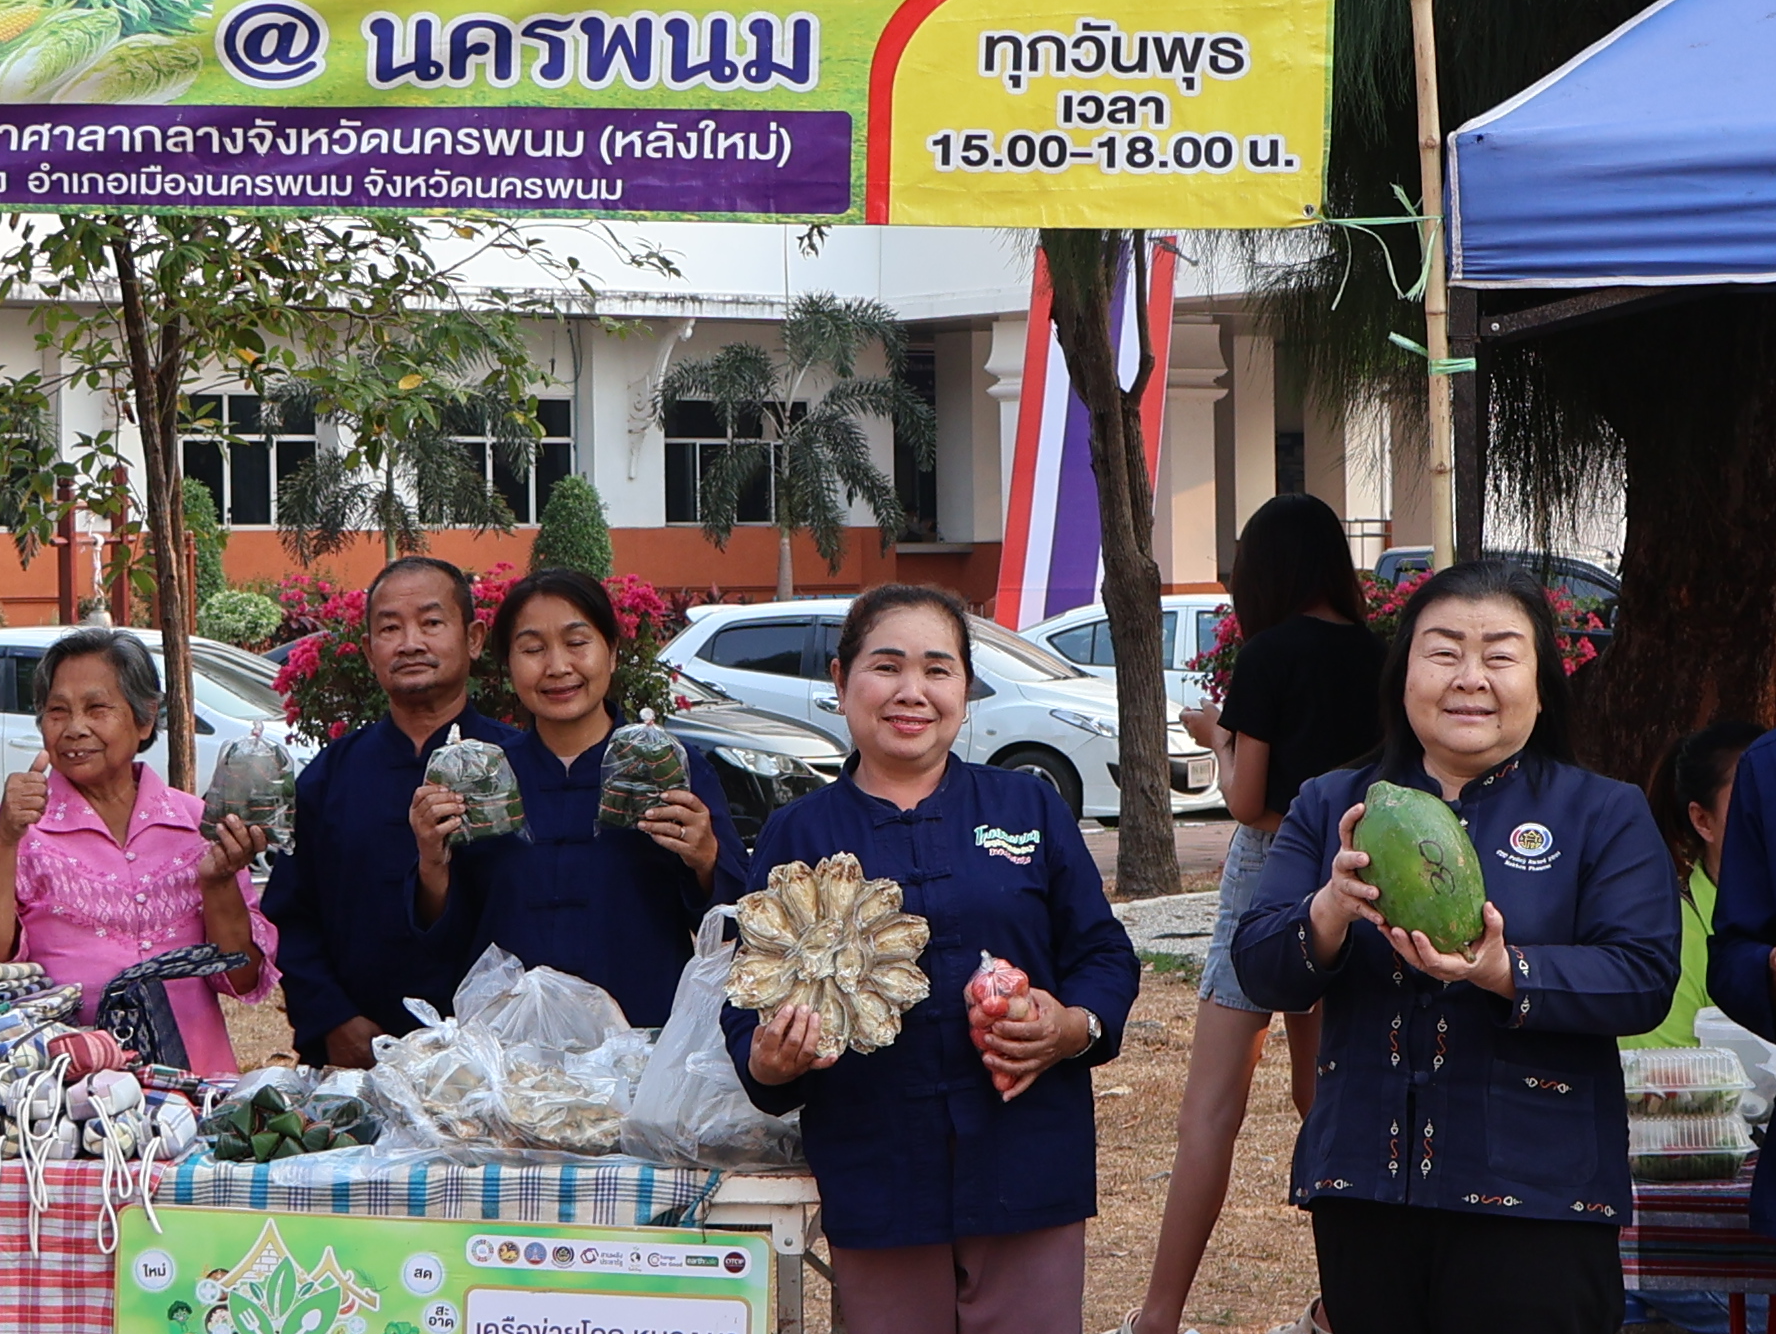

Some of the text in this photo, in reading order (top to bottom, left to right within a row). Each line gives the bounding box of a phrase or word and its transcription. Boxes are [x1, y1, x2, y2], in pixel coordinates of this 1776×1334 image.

[220, 1, 816, 91] @ นครพนม
[979, 20, 1247, 95] ทุกวันพุธ
[1058, 94, 1166, 129] เวลา
[599, 119, 792, 167] (หลังใหม่)
[1244, 137, 1297, 171] น.
[27, 163, 352, 199] อำเภอเมืองนครพนม
[364, 169, 623, 202] จังหวัดนครพนม
[143, 1263, 167, 1278] ใหม่
[414, 1267, 433, 1280] สด
[428, 1315, 454, 1329] อาด
[435, 1305, 450, 1317] สะ
